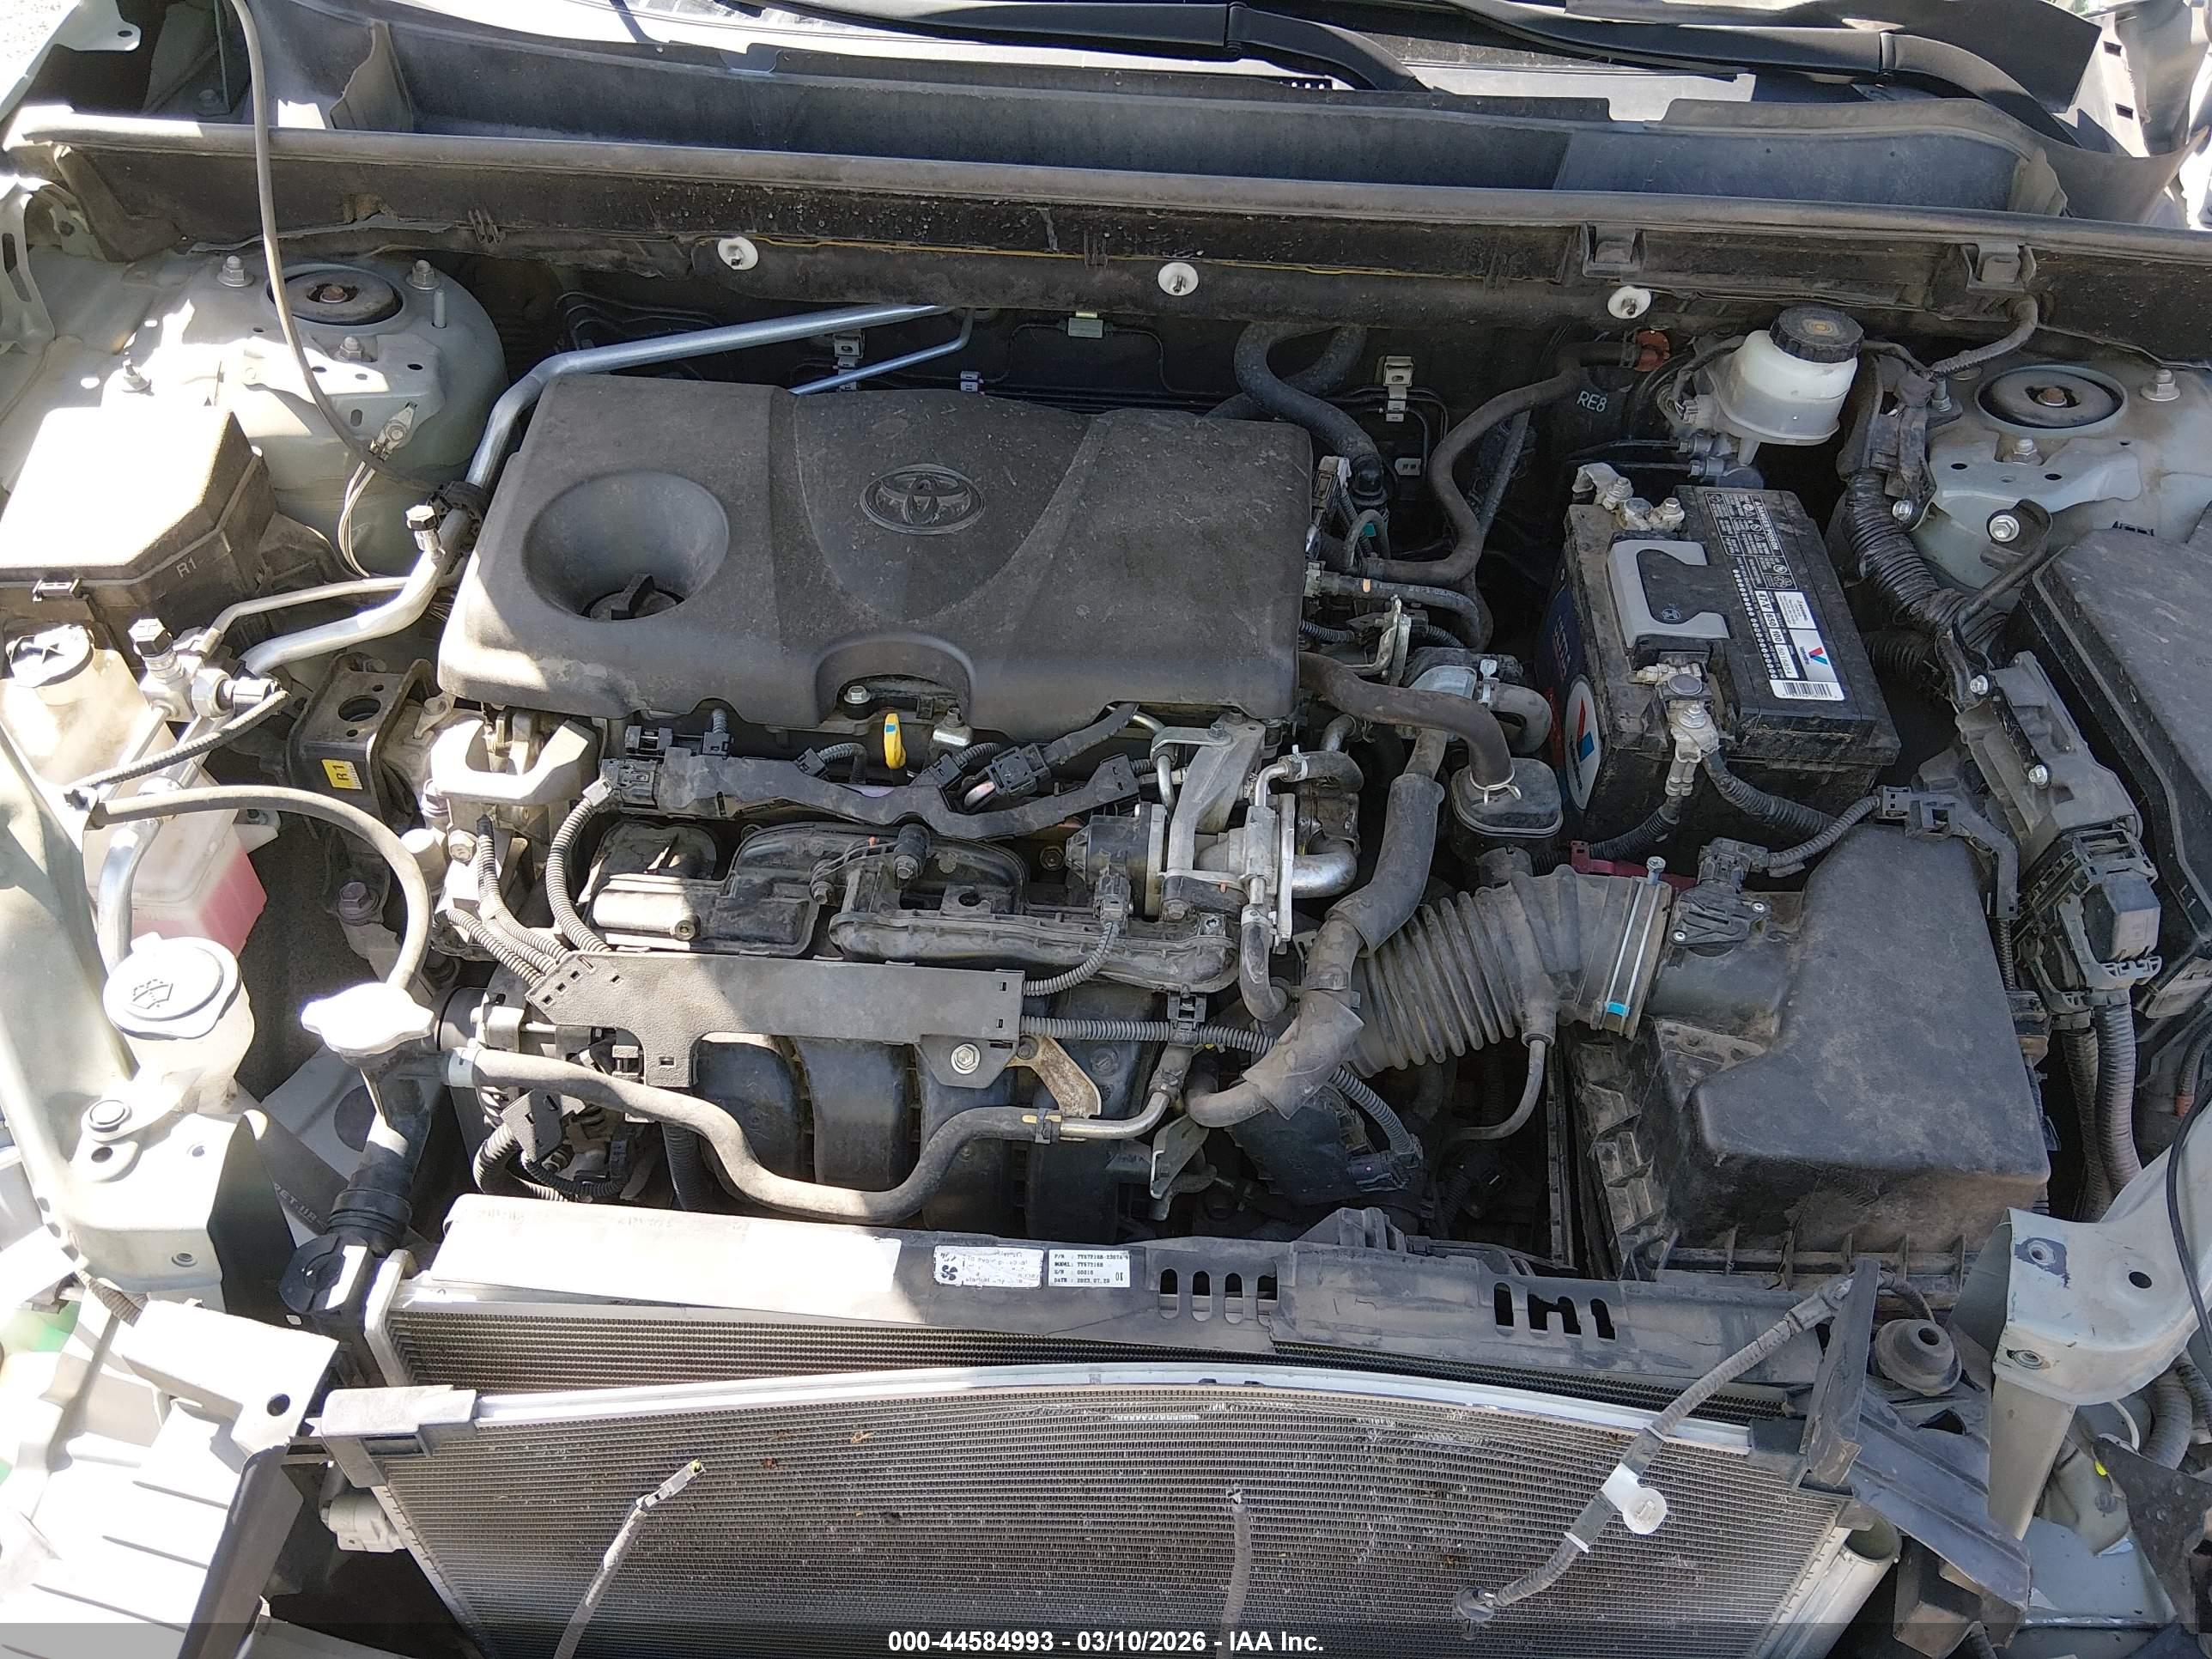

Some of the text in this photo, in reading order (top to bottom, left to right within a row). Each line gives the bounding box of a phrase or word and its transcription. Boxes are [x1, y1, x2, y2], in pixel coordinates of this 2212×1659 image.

[1577, 391, 1607, 412] RE8
[176, 556, 197, 578] R1
[1765, 614, 1777, 625] 650
[1771, 630, 1782, 641] 100
[332, 765, 349, 781] R1
